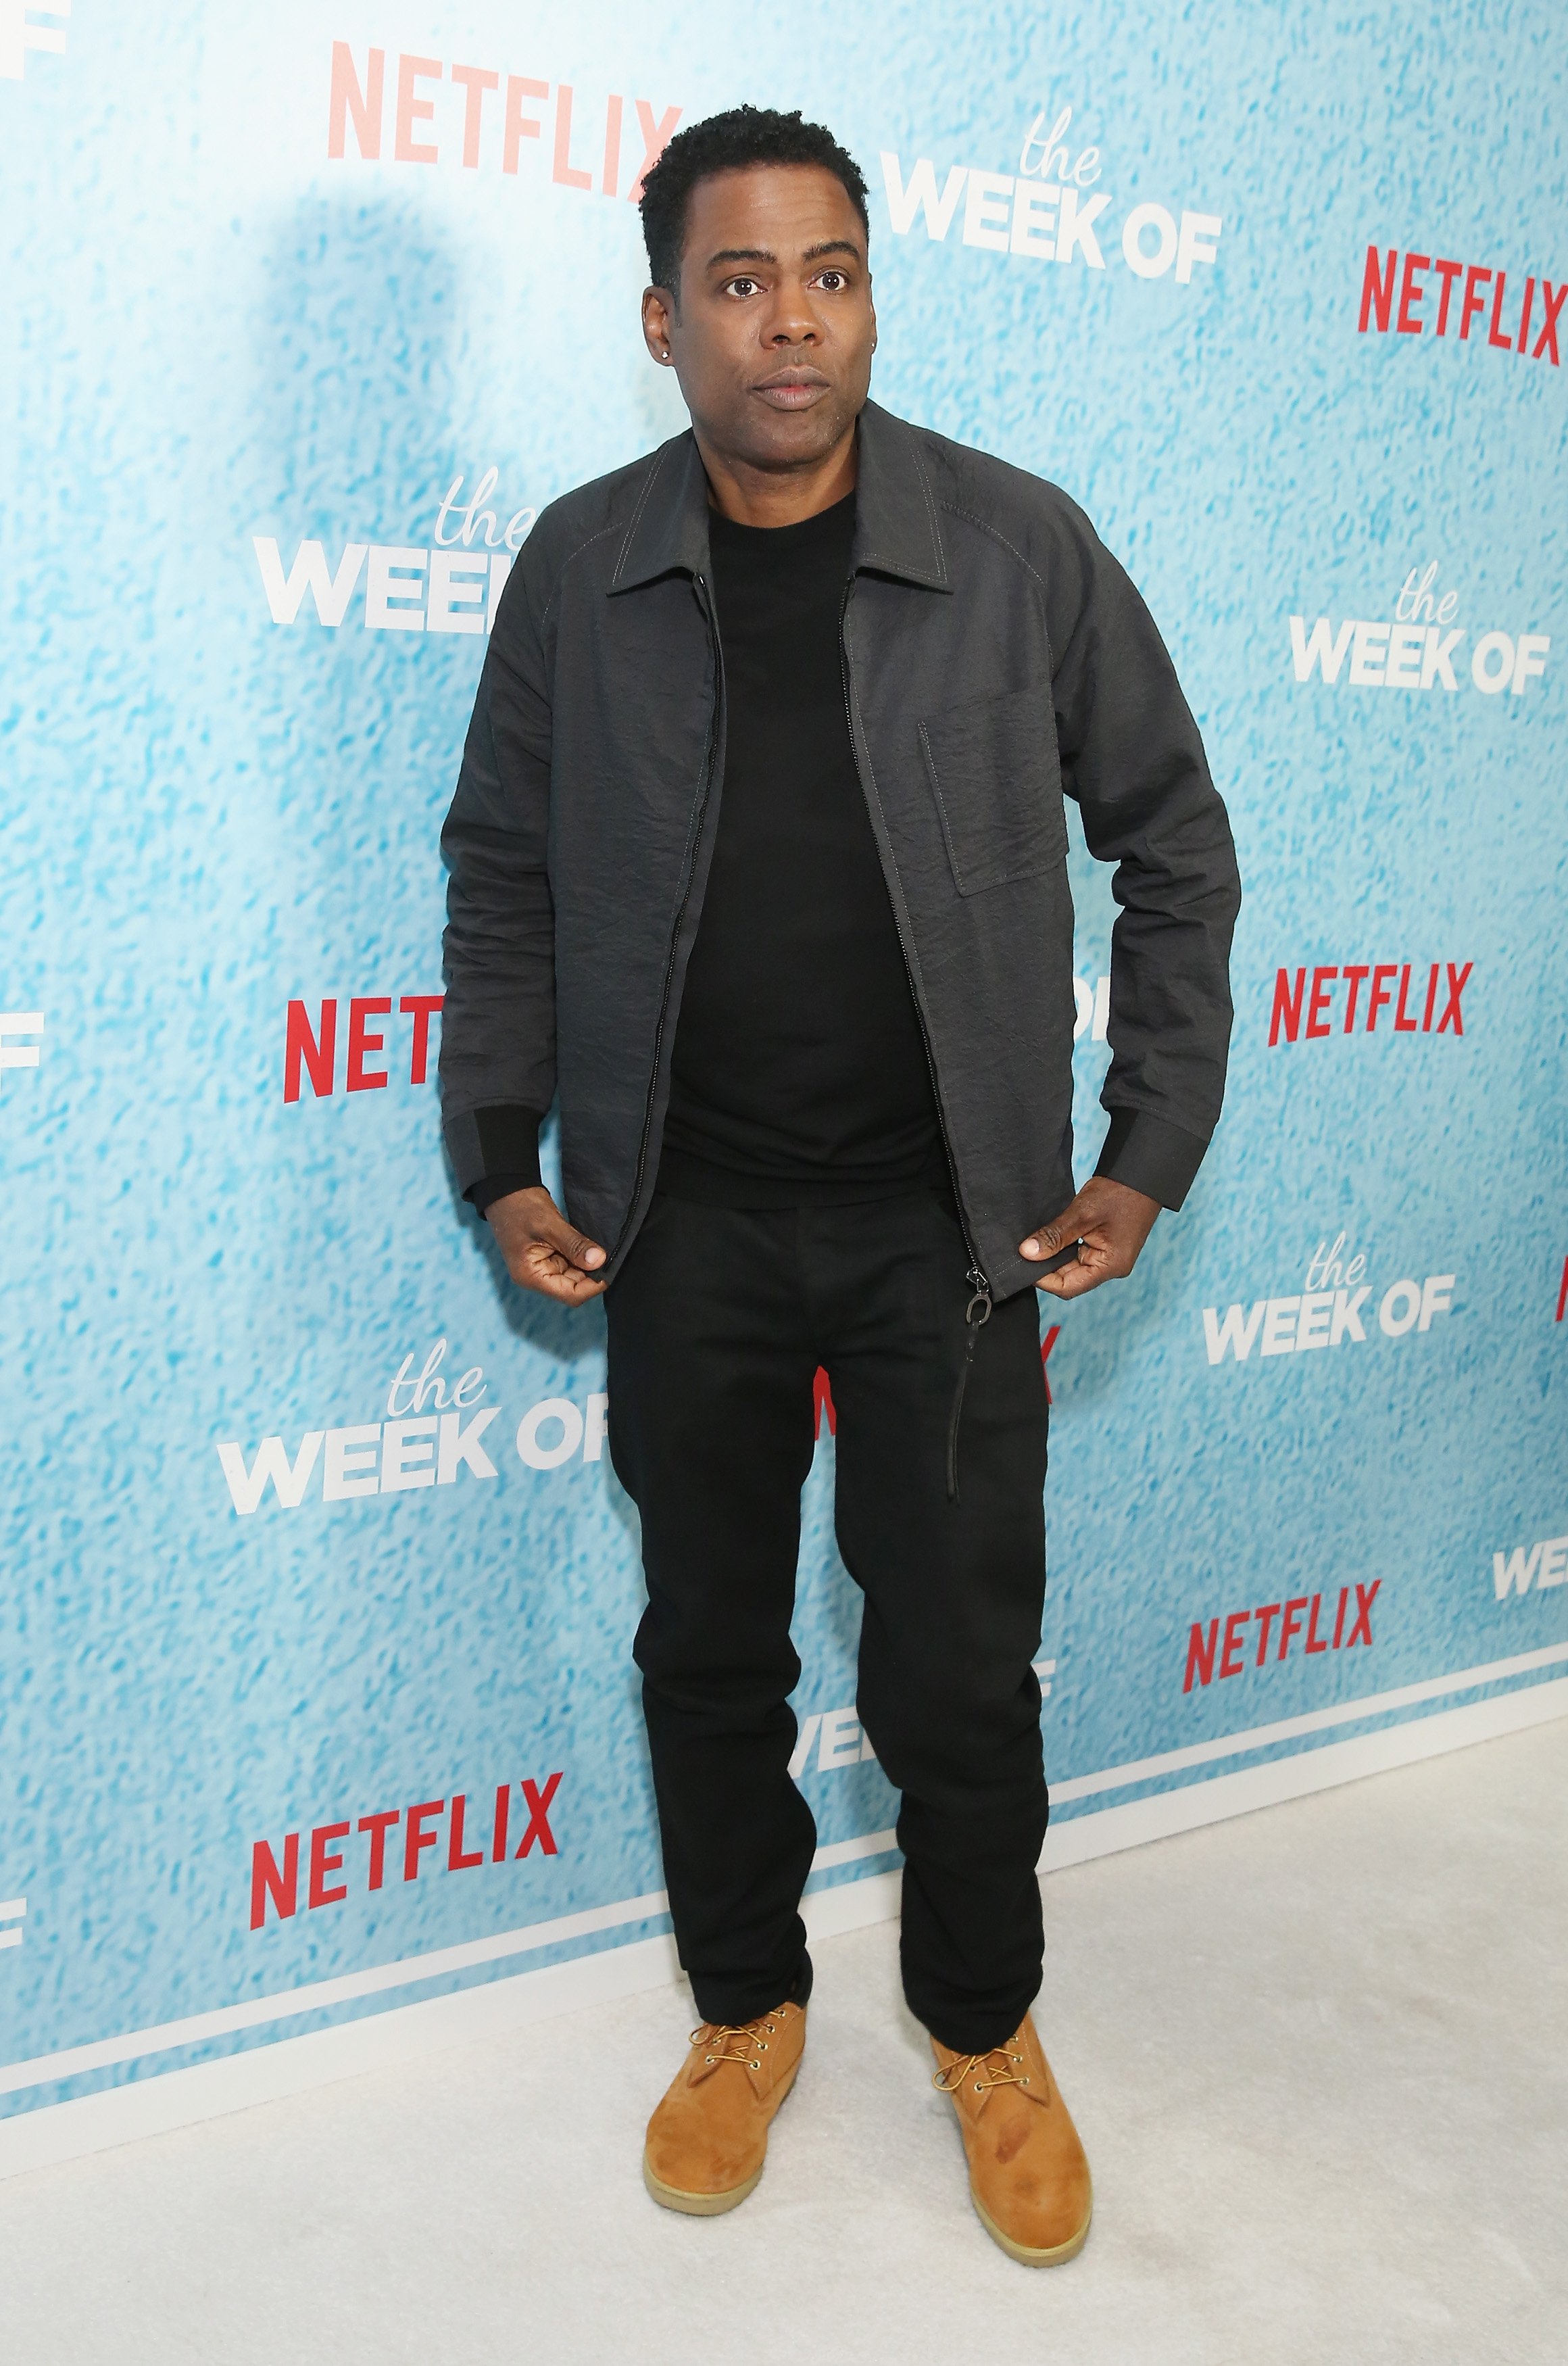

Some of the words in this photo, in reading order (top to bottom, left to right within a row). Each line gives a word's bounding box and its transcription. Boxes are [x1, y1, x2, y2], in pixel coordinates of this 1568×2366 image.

[326, 40, 684, 205] NETFLIX
[1019, 105, 1102, 187] the
[879, 150, 1112, 270] WEEK
[1122, 201, 1223, 284] OF
[1357, 245, 1568, 367] NETFLIX
[434, 466, 537, 551] the
[1396, 559, 1460, 626] the
[1289, 615, 1467, 692] WEEK
[1471, 629, 1551, 696] OF
[1268, 962, 1474, 1048] NETFLIX
[1304, 1230, 1367, 1293] the
[1202, 1286, 1373, 1366] WEEK
[1379, 1274, 1456, 1338] OF
[386, 1337, 487, 1418] the
[216, 1406, 501, 1516] WEEK
[1183, 1579, 1382, 1694] NETFLIX
[249, 1771, 564, 1931] NETFLIX
